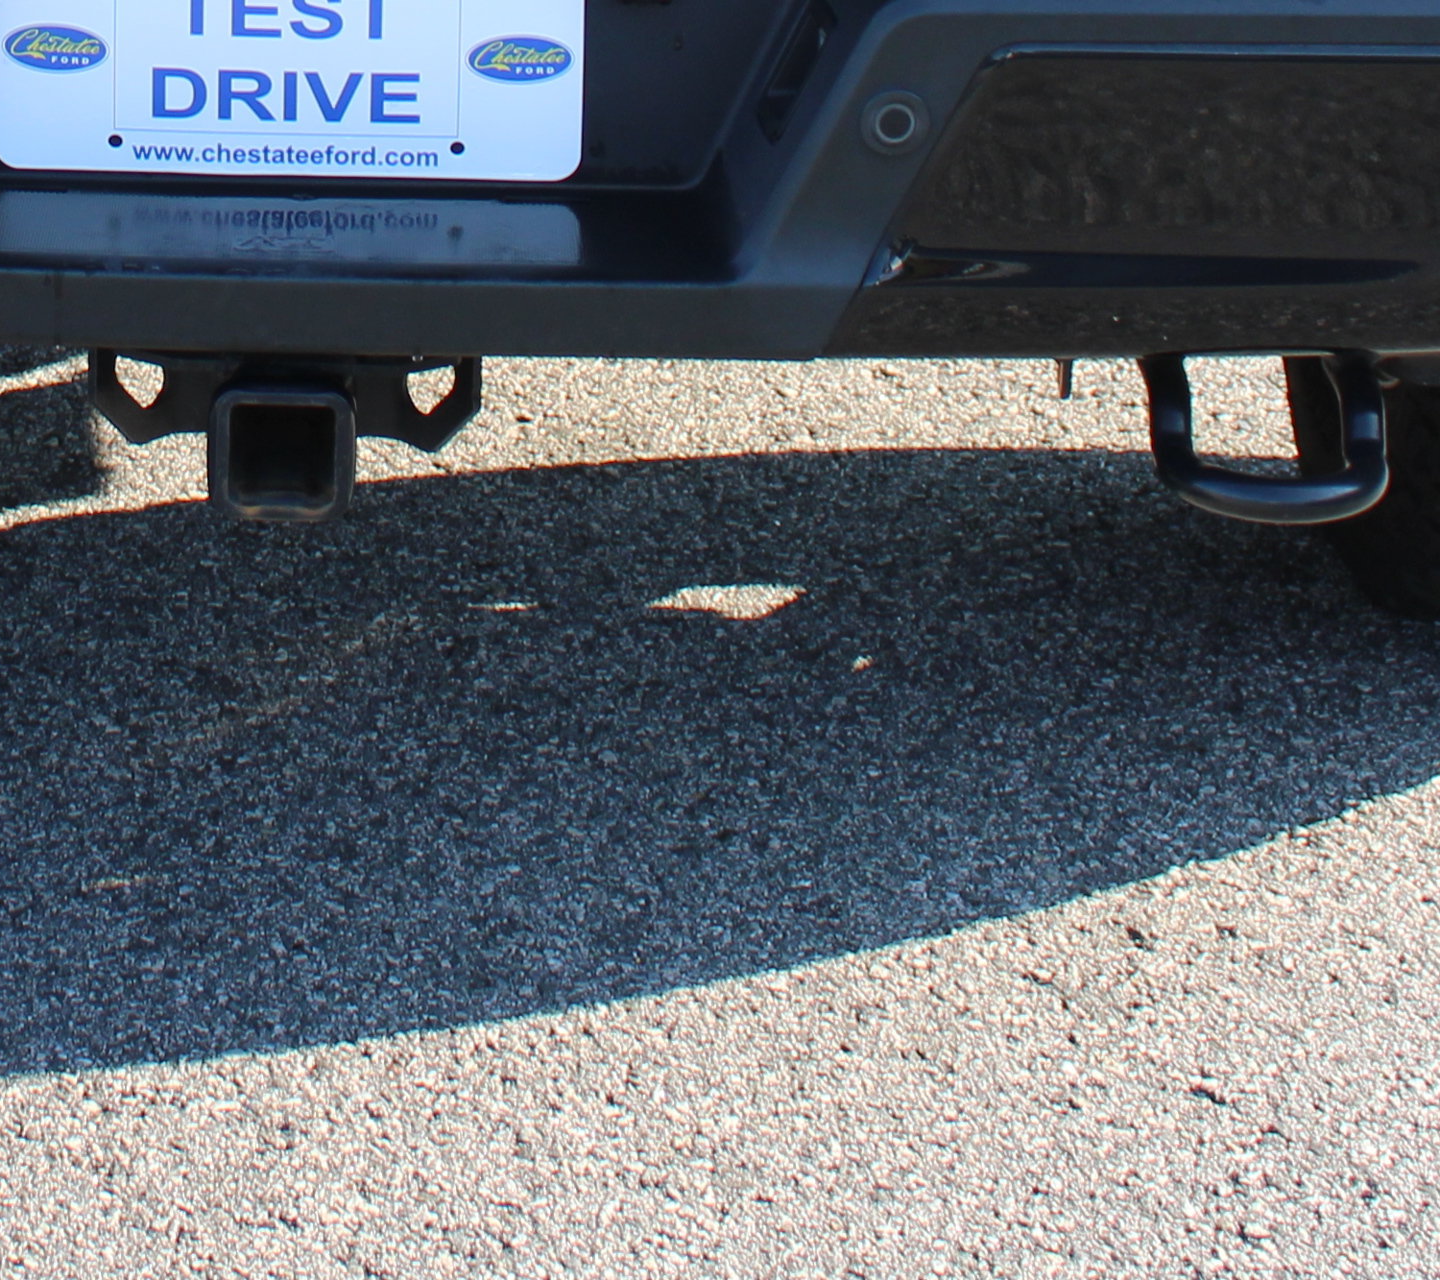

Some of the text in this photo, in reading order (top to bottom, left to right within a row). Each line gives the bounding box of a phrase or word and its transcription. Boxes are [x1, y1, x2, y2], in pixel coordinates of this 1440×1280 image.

[11, 28, 101, 60] Chestatee
[474, 40, 566, 72] Chestatee
[50, 55, 90, 65] FORD
[514, 66, 556, 75] FORD
[150, 66, 422, 124] DRIVE
[132, 142, 439, 168] www.chestateeford.com
